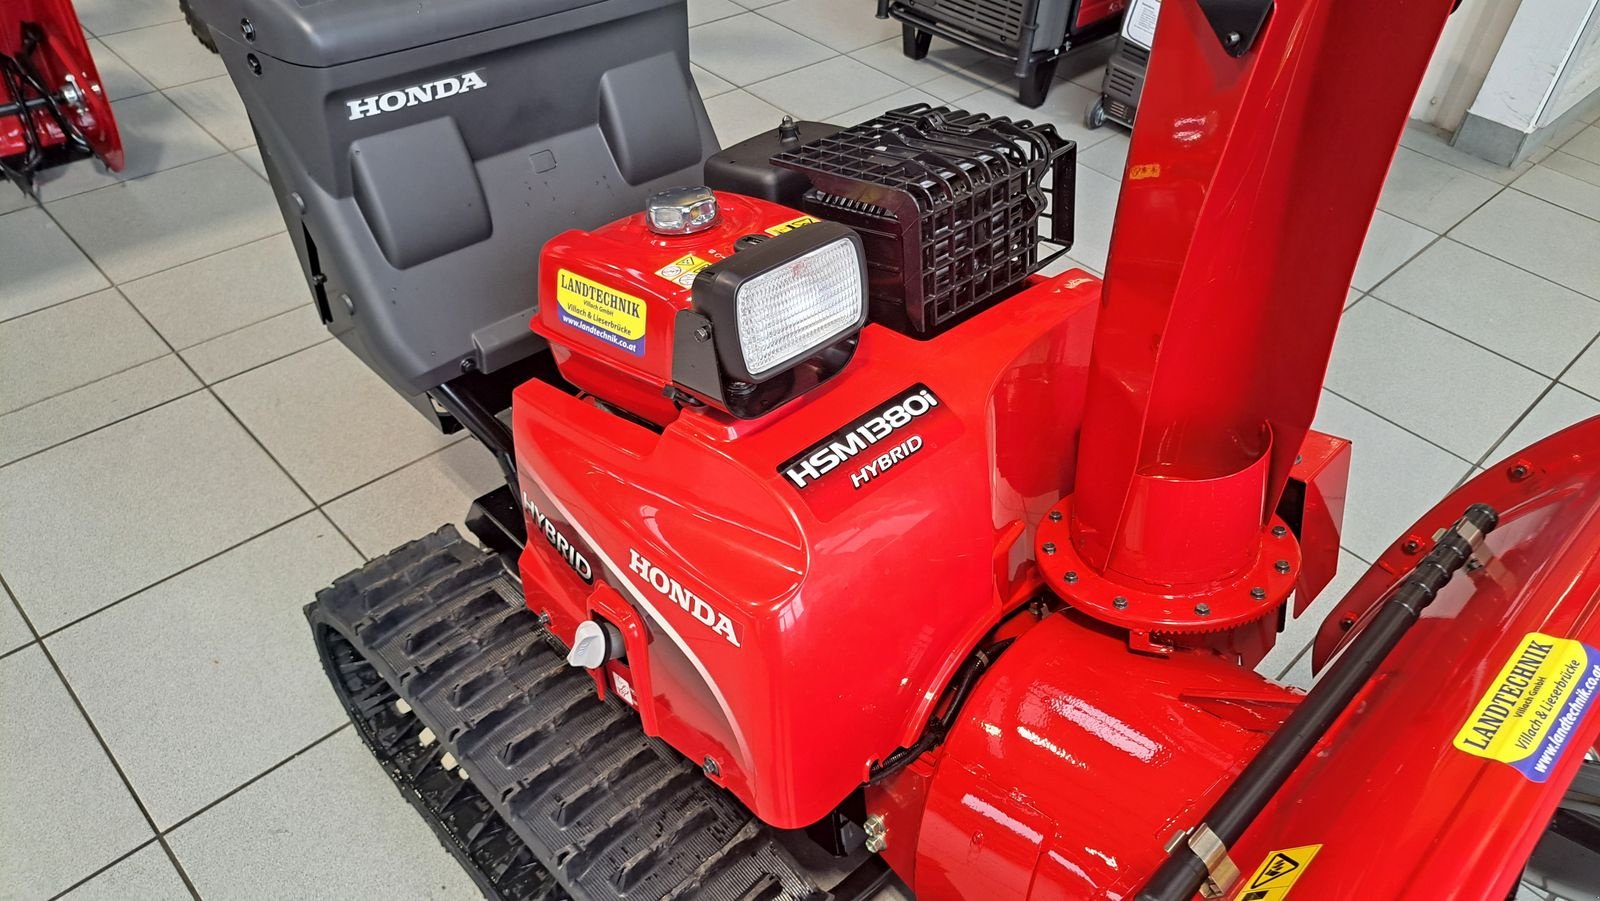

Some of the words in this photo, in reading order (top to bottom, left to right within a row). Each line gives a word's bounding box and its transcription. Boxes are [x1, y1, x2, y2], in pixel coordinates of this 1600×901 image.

[346, 71, 487, 121] HONDA
[561, 274, 640, 319] LANDTECHNIK
[567, 303, 587, 317] Villach
[587, 311, 593, 319] &
[592, 314, 632, 336] Lieserbrücke
[583, 300, 599, 311] Villach
[599, 306, 614, 317] GmbH
[562, 315, 637, 352] www.landtechnik.co.at
[786, 389, 938, 488] HSM1380i
[850, 435, 924, 489] HYBRID
[523, 491, 592, 580] HYBRID
[628, 548, 741, 648] HONDA
[1464, 640, 1553, 750] LANDTECHNIK
[1513, 695, 1534, 718] Villach
[1530, 676, 1547, 698] GmbH
[1540, 659, 1580, 712] Lieserbrücke
[1515, 718, 1542, 750] Villach
[1535, 710, 1548, 720] &
